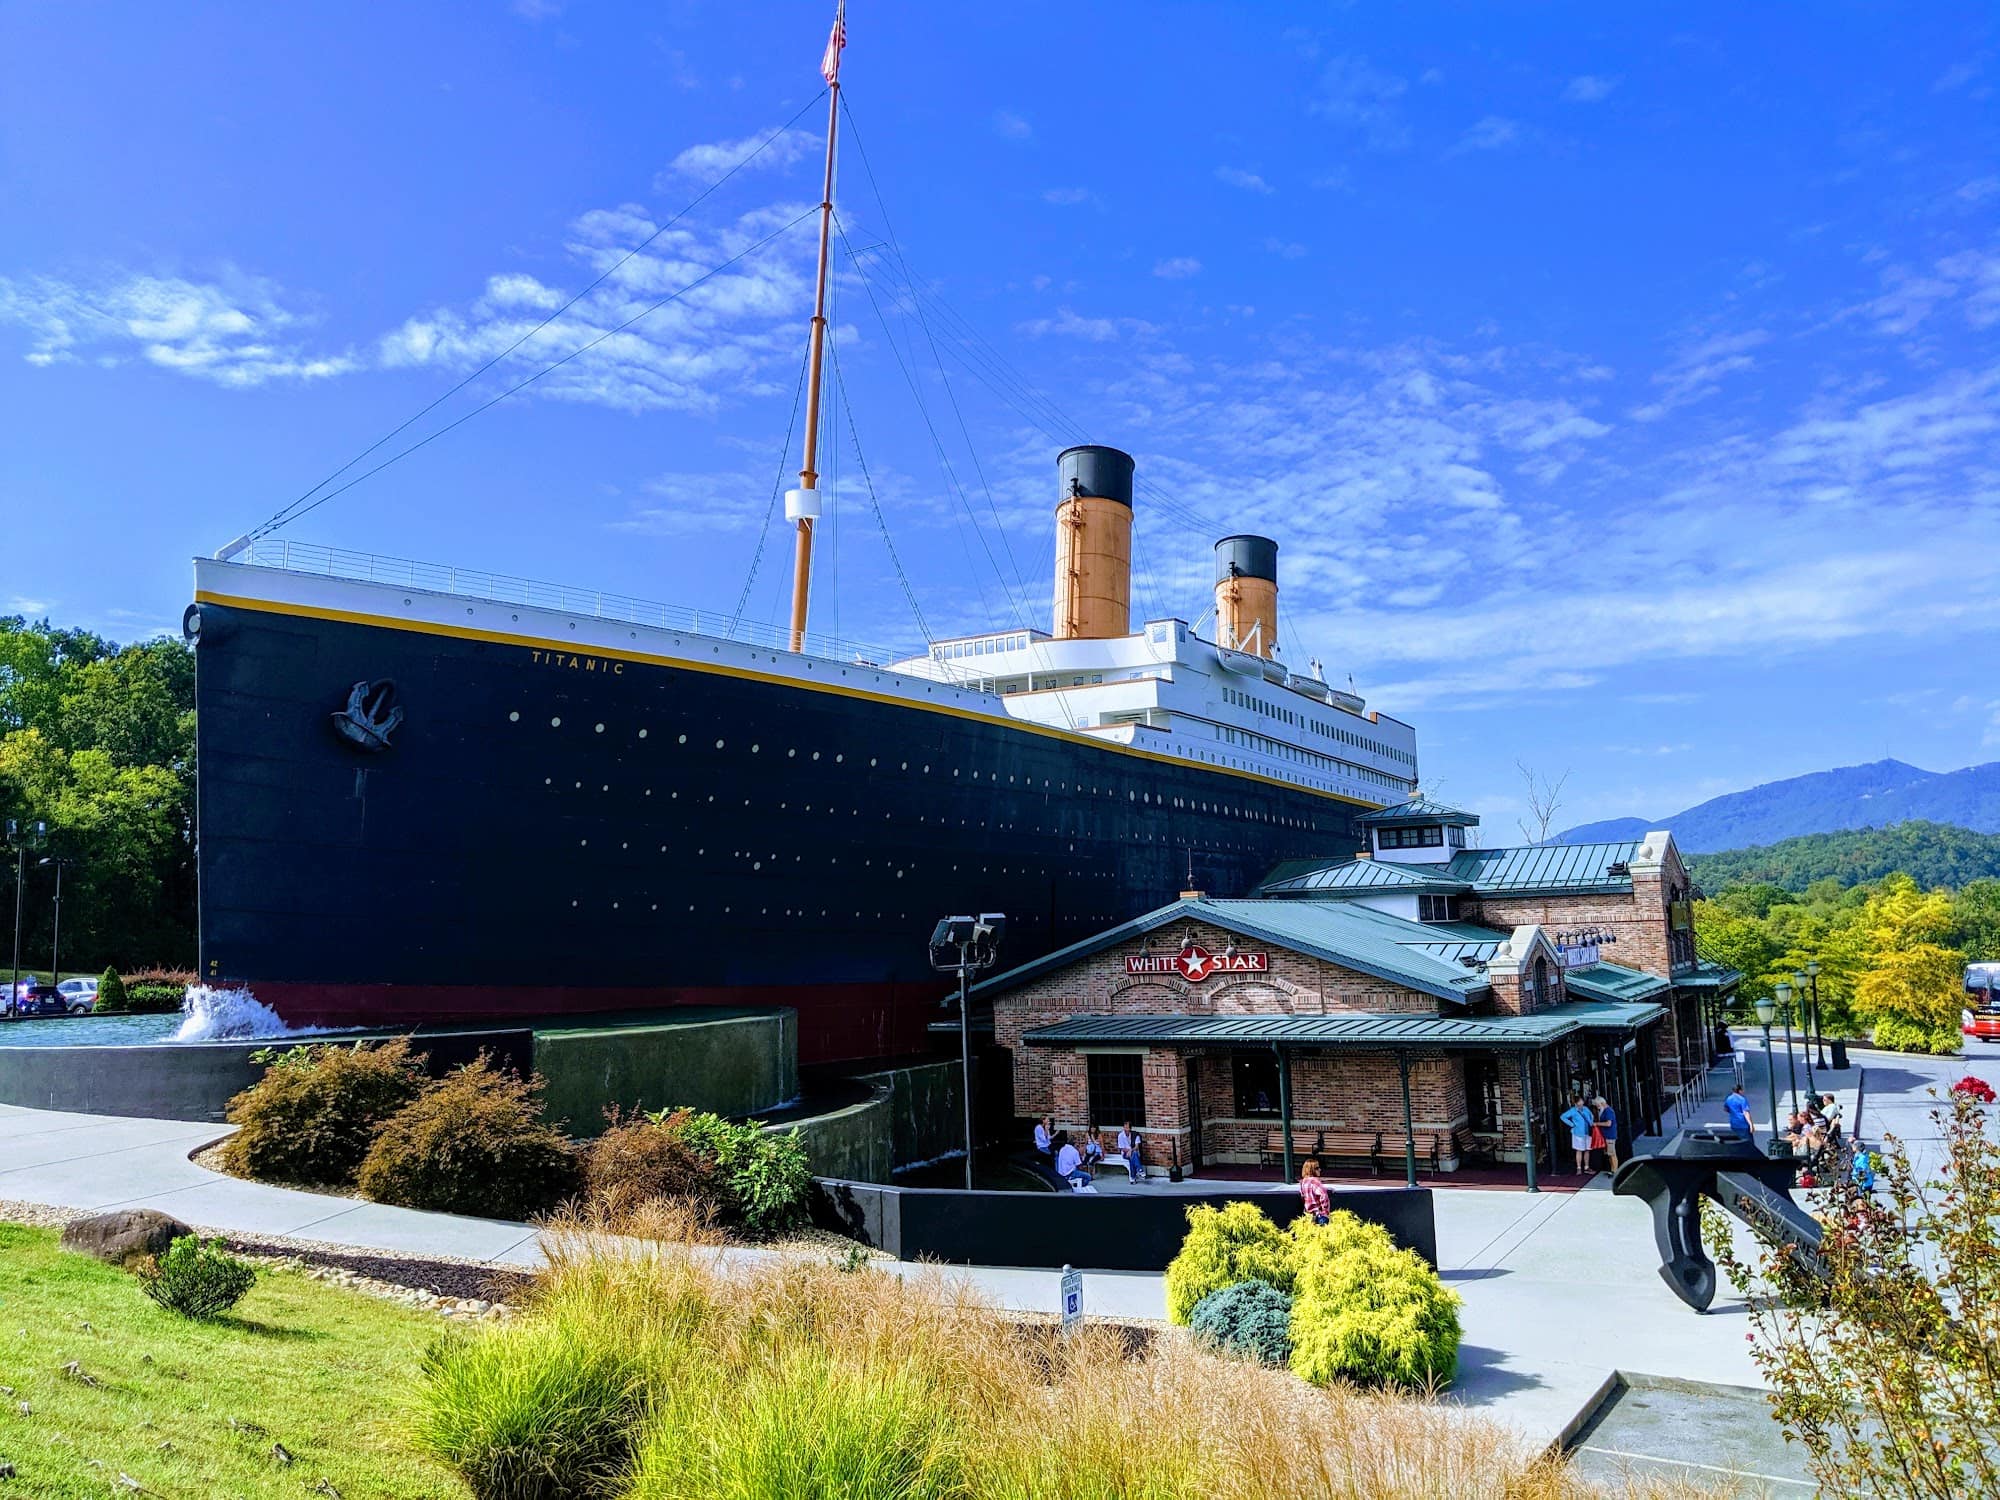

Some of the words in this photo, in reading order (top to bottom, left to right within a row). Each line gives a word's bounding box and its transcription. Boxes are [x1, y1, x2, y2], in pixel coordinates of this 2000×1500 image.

[532, 651, 624, 674] TITANIC
[1130, 957, 1179, 971] WHITE
[1212, 955, 1262, 969] STAR
